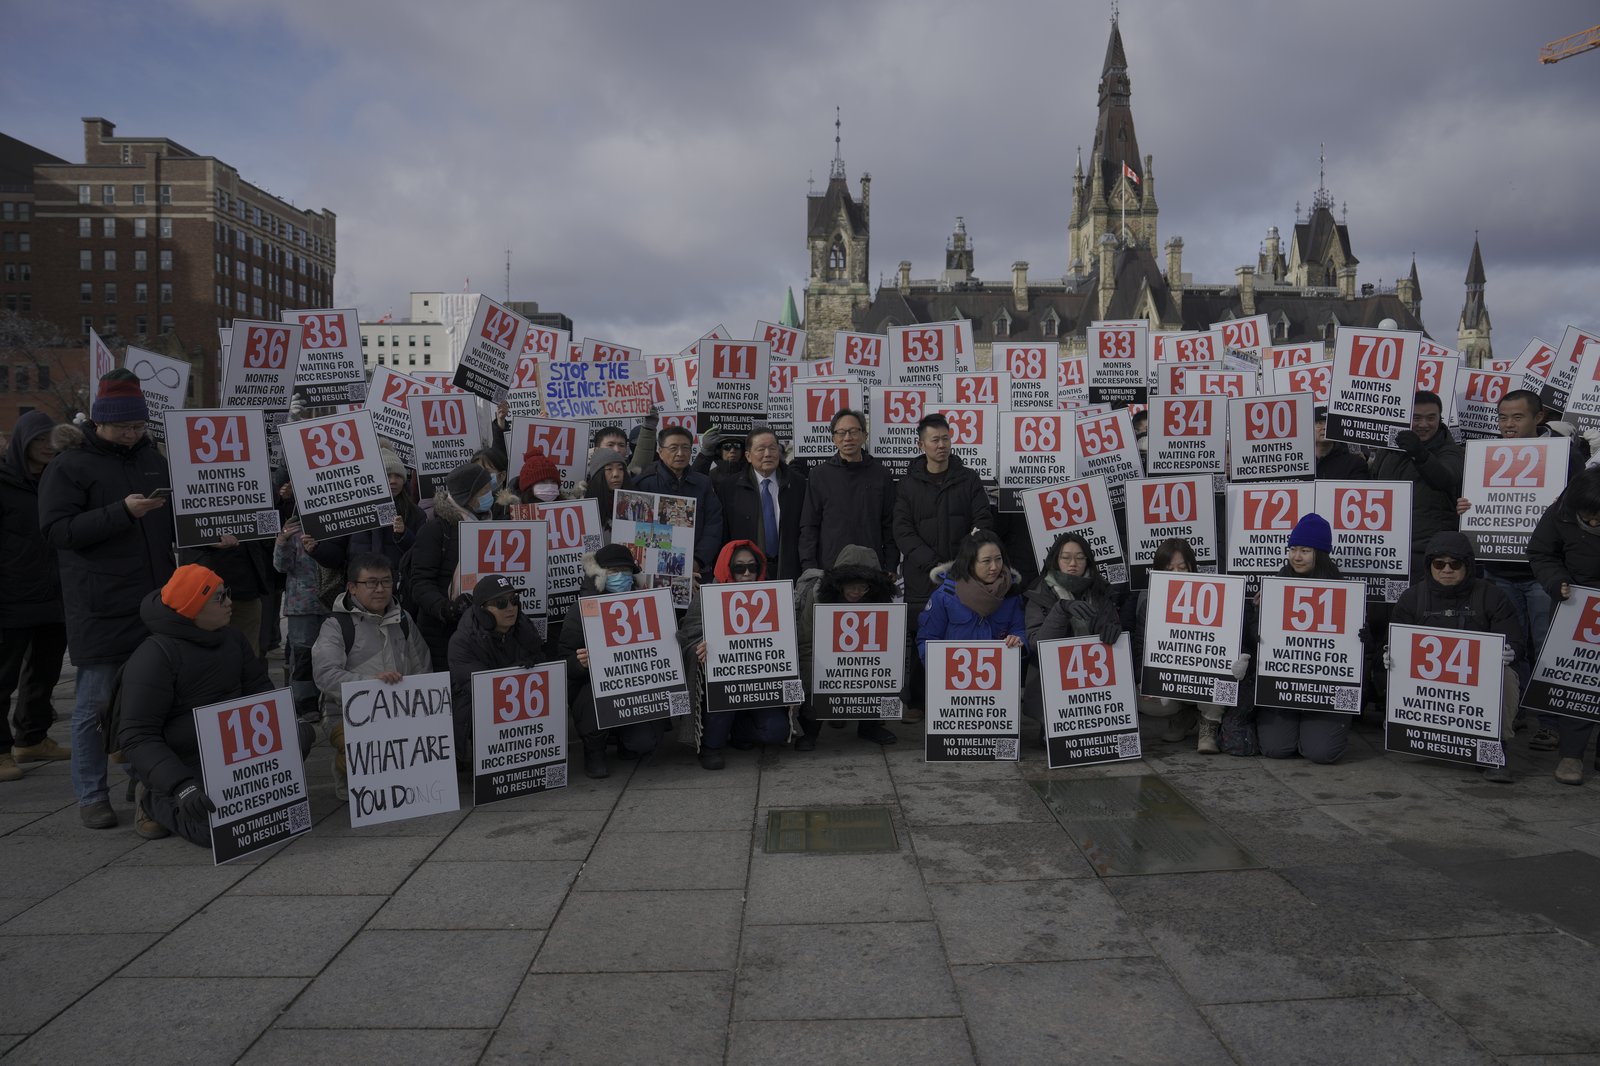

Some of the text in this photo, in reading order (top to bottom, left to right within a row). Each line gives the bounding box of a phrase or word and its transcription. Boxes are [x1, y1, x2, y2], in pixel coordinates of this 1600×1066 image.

[303, 314, 343, 348] 35
[485, 308, 515, 347] 42
[1226, 322, 1255, 349] 20
[248, 328, 286, 368] 36
[848, 337, 877, 366] 34
[907, 330, 939, 362] 53
[1102, 331, 1132, 358] 33
[1180, 337, 1210, 362] 38
[717, 345, 752, 379] 11
[1011, 349, 1042, 379] 68
[1354, 336, 1399, 378] 70
[245, 373, 279, 383] MONTHS
[550, 361, 629, 381] STOP THE
[769, 366, 792, 393] 31
[234, 385, 285, 394] WAITING FOR
[707, 392, 759, 401] WAITING FOR
[716, 382, 751, 391] MONTHS
[960, 378, 995, 403] 34
[1352, 380, 1393, 394] MONTHS
[1471, 375, 1504, 404] 16
[228, 397, 288, 406] IRCC RESPONSE
[702, 401, 763, 411] IRCC RESPONSE
[888, 391, 922, 423] 53
[1334, 401, 1407, 419] IRCC RESPONSE
[1341, 391, 1402, 406] WAITING FOR
[428, 400, 461, 435] 40
[1168, 400, 1207, 436] 34
[1250, 401, 1293, 439] 90
[192, 416, 244, 463] 34
[306, 421, 357, 467] 38
[533, 426, 569, 465] 54
[1019, 417, 1057, 451] 68
[1082, 418, 1119, 455] 55
[198, 468, 246, 481] MONTHS
[316, 465, 361, 483] MONTHS
[1489, 445, 1541, 487] 22
[187, 480, 259, 495] WAITING FOR
[304, 485, 384, 509] IRCC RESPONSE
[307, 475, 375, 496] WAITING FOR
[181, 493, 267, 509] IRCC RESPONSE
[1046, 486, 1089, 528] 39
[1147, 482, 1192, 523] 40
[1249, 490, 1292, 529] 72
[1340, 489, 1387, 531] 65
[195, 512, 257, 527] NO TIMELINES
[200, 523, 255, 537] NO RESULTS
[483, 530, 526, 572] 42
[727, 589, 773, 634] 62
[1171, 580, 1219, 625] 40
[1288, 586, 1340, 632] 51
[606, 598, 655, 645] 31
[838, 611, 883, 651] 81
[729, 638, 774, 651] MONTHS
[1169, 629, 1216, 643] MONTHS
[1286, 636, 1337, 650] MONTHS
[613, 647, 658, 663] MONTHS
[719, 650, 786, 664] WAITING FOR
[1157, 642, 1227, 657] WAITING FOR
[1273, 649, 1349, 664] WAITING FOR
[1417, 635, 1473, 684] 34
[603, 658, 671, 677] WAITING FOR
[713, 662, 793, 677] IRCC RESPONSE
[837, 657, 881, 666] MONTHS
[951, 648, 996, 690] 35
[1064, 643, 1111, 689] 43
[1150, 654, 1233, 671] IRCC RESPONSE
[1265, 661, 1356, 678] IRCC RESPONSE
[599, 671, 679, 692] IRCC RESPONSE
[819, 680, 897, 690] IRCC RESPONSE
[826, 669, 892, 678] WAITING FOR
[499, 673, 544, 722] 36
[724, 681, 782, 694] NO TIMELINES
[728, 691, 780, 703] NO RESULTS
[1067, 691, 1112, 706] MONTHS
[1416, 685, 1471, 702] MONTHS
[344, 686, 452, 727] CANADA
[950, 696, 995, 706] MONTHS
[1058, 703, 1124, 719] WAITING FOR
[1402, 697, 1484, 717] WAITING FOR
[939, 708, 1007, 718] WAITING FOR
[1053, 715, 1132, 733] IRCC RESPONSE
[1394, 709, 1492, 732] IRCC RESPONSE
[224, 702, 276, 761] 18
[499, 723, 544, 740] MONTHS
[933, 720, 1013, 730] IRCC RESPONSE
[488, 734, 555, 755] WAITING FOR
[1406, 729, 1476, 748] NO TIMELINES
[1410, 740, 1473, 758] NO RESULTS
[346, 735, 450, 776] WHAT ARE
[481, 747, 561, 770] IRCC RESPONSE
[232, 758, 279, 782] MONTHS
[222, 770, 292, 801] WAITING FOR
[217, 783, 300, 819] IRCC RESPONSE
